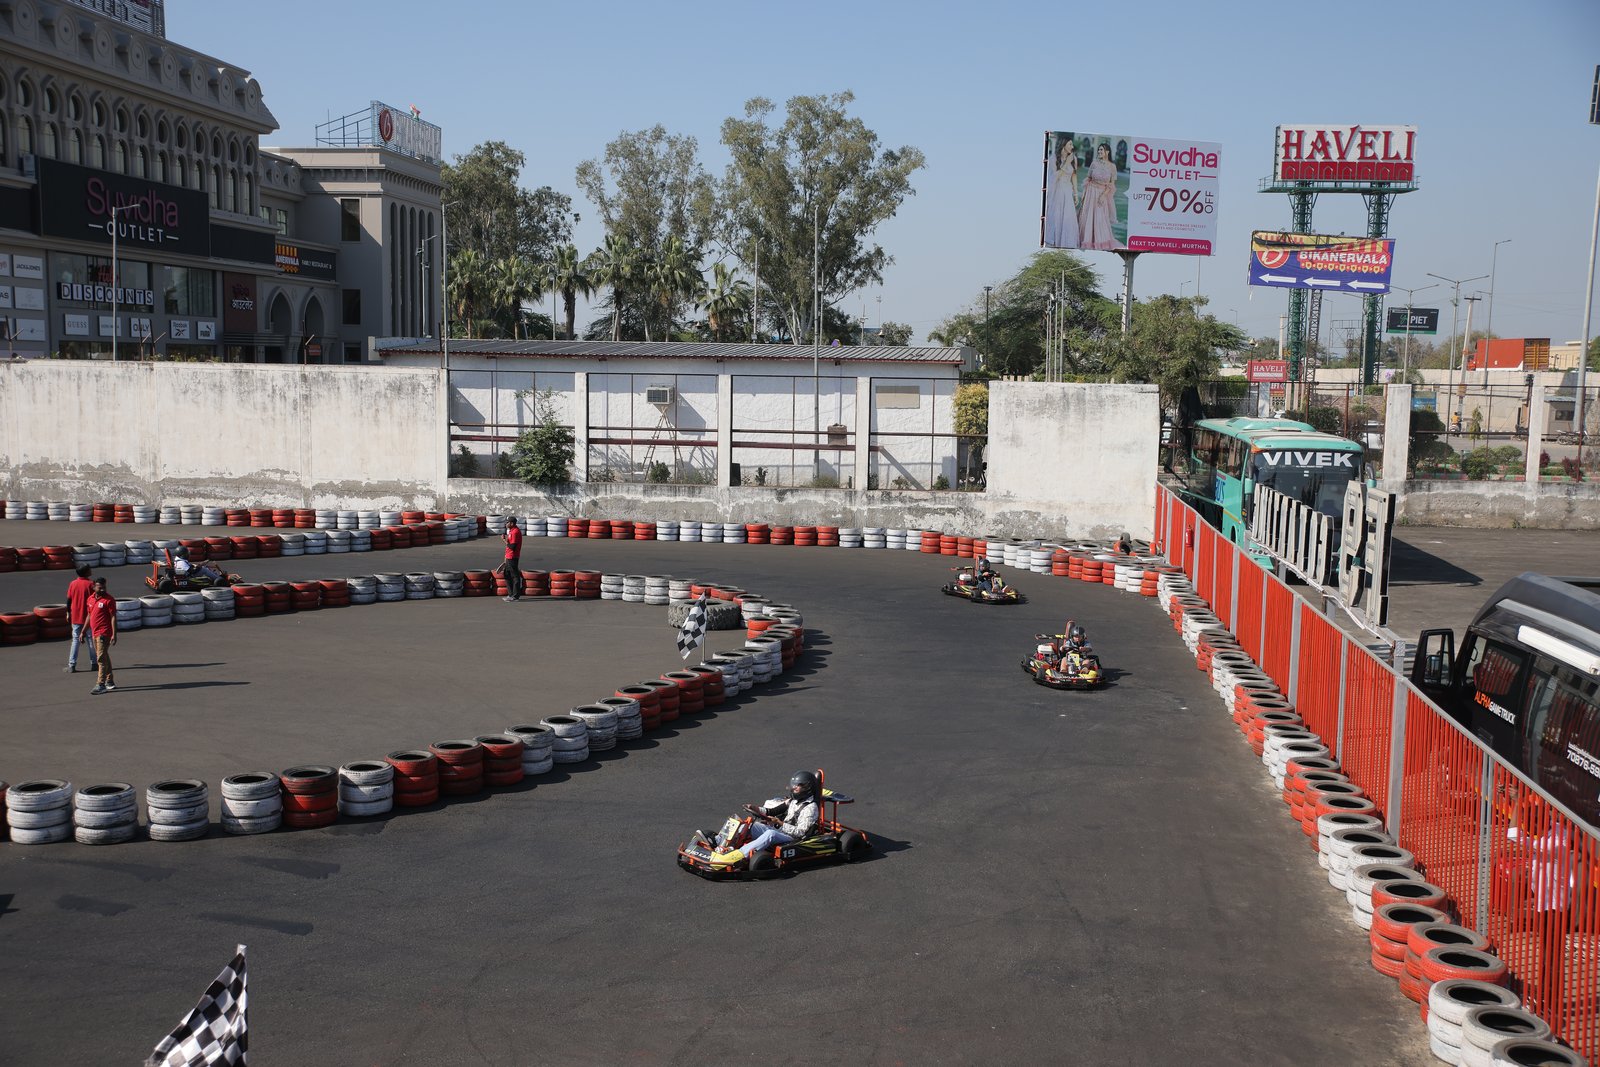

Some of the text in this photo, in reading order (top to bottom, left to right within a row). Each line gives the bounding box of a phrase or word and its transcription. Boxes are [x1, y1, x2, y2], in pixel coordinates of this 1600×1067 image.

[1282, 124, 1416, 161] HAVELI
[1133, 143, 1218, 168] Suvidha
[1149, 169, 1200, 181] OUTLET
[87, 177, 178, 227] Suvidha
[1133, 187, 1214, 214] UPTO 70% OFF
[106, 220, 163, 243] OUTLET
[1299, 251, 1388, 265] BIKANERVALA
[62, 284, 153, 304] DISCOUNTS
[133, 323, 150, 332] OLY
[1410, 315, 1428, 324] PIET
[1262, 451, 1354, 467] VIVEK
[1566, 749, 1600, 779] 70876-59
[782, 848, 796, 858] 19
